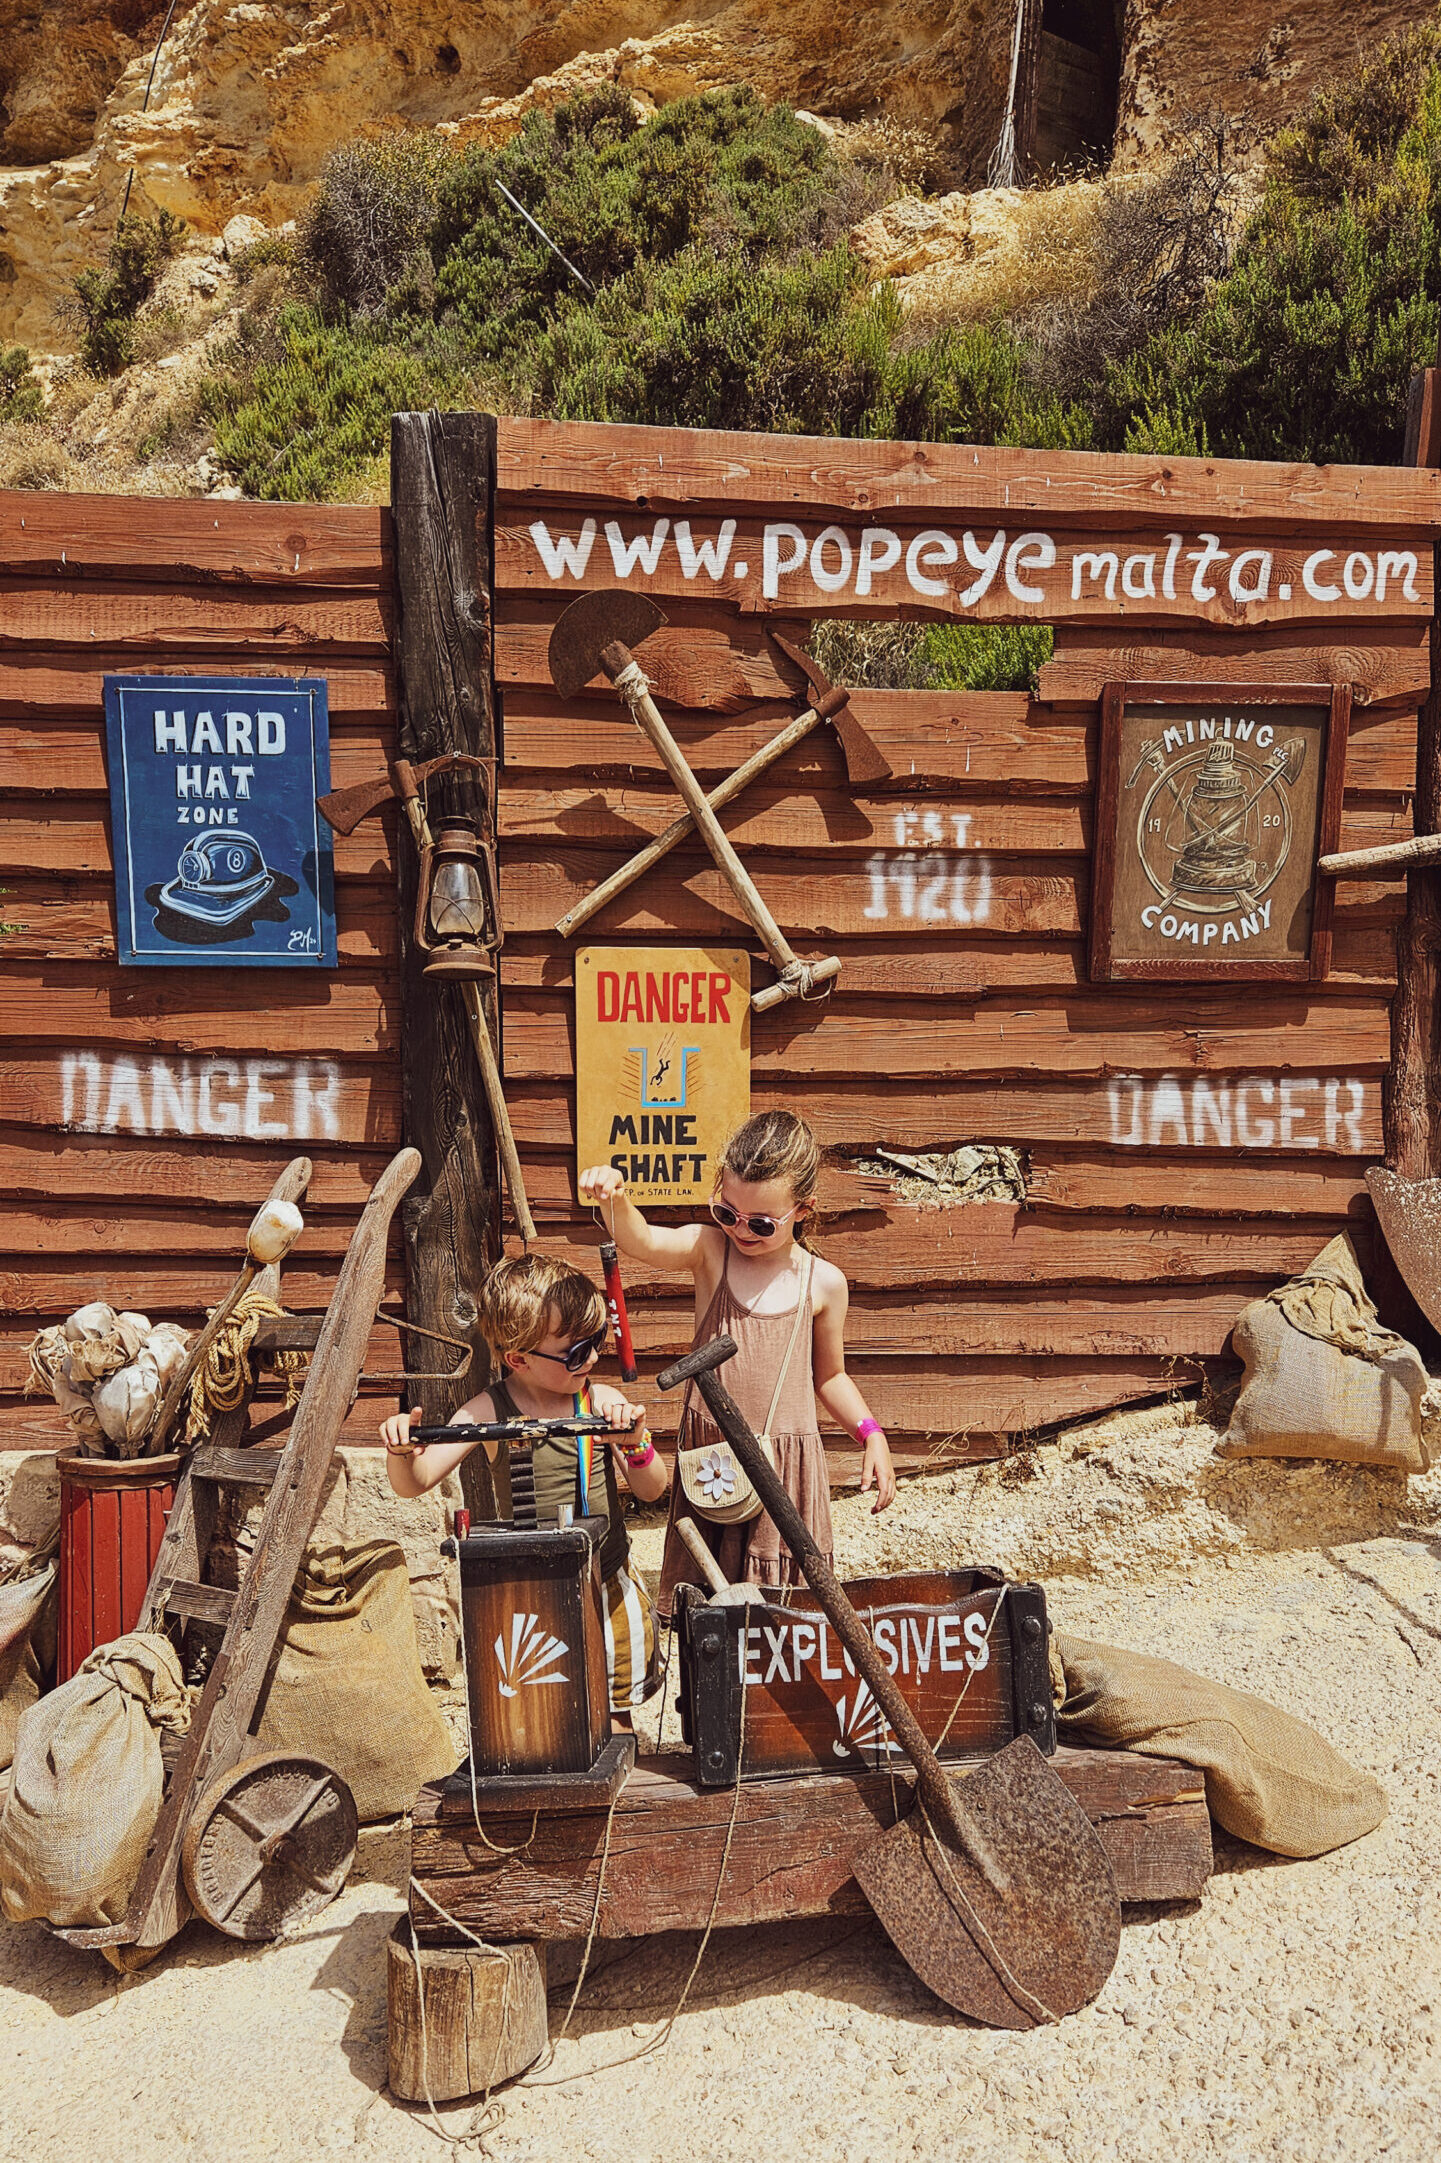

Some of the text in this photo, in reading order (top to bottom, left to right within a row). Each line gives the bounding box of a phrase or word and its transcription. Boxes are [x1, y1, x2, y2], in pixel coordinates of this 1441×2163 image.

[154, 709, 287, 756] HARD
[1162, 717, 1274, 753] MINING
[176, 763, 256, 801] HAT
[177, 806, 239, 825] ZONE
[894, 811, 982, 848] EST.
[1148, 815, 1280, 833] 19 20
[864, 852, 993, 922] 1920
[1141, 899, 1272, 946] COMPANY
[597, 971, 731, 1024] DANGER
[60, 1053, 340, 1137] DANGER
[1108, 1074, 1364, 1153] DANGER
[609, 1115, 698, 1145] MINE
[611, 1154, 707, 1182] SHAFT
[648, 1188, 672, 1196] STATE
[609, 1299, 622, 1337] TNT
